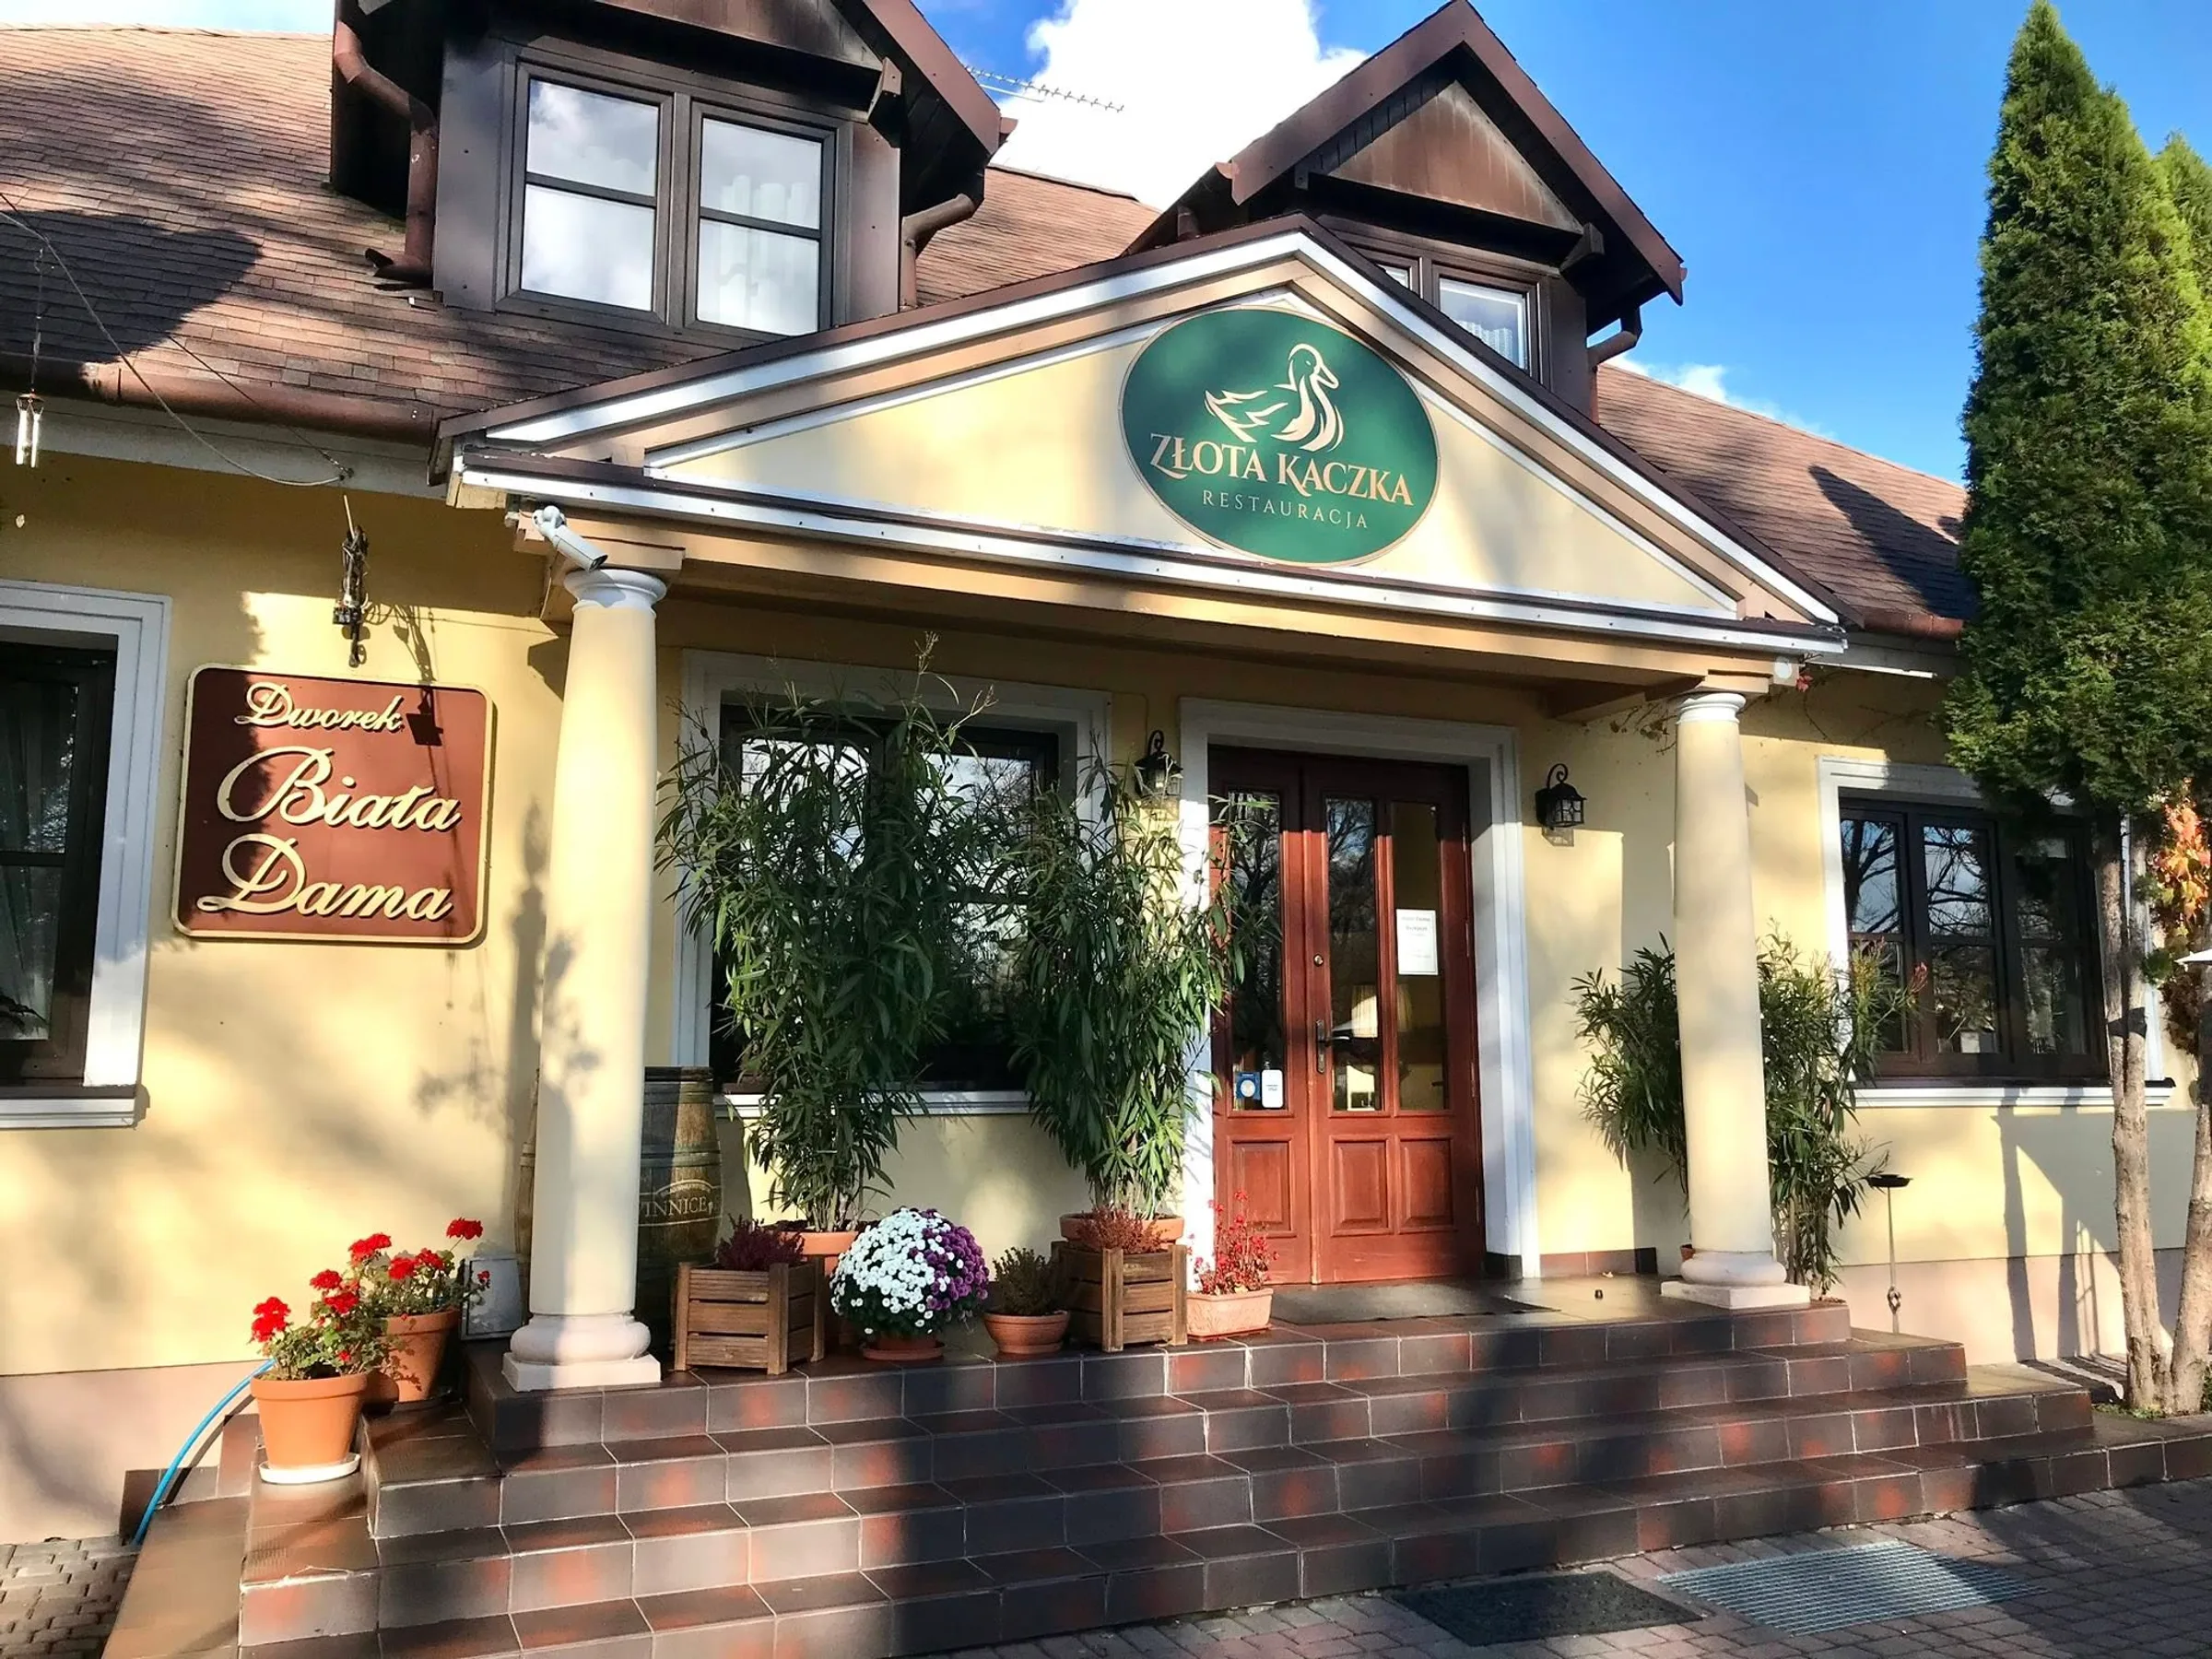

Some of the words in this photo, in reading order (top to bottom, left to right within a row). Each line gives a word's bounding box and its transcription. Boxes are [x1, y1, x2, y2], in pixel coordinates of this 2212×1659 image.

[1150, 433, 1266, 482] ZŁOTA
[1277, 453, 1414, 506] KACZKA
[1203, 489, 1368, 528] RESTAURACJA
[234, 681, 405, 732] Dworek
[217, 746, 462, 830] Biała
[196, 833, 453, 920] Dama
[639, 1196, 707, 1217] INNICE
